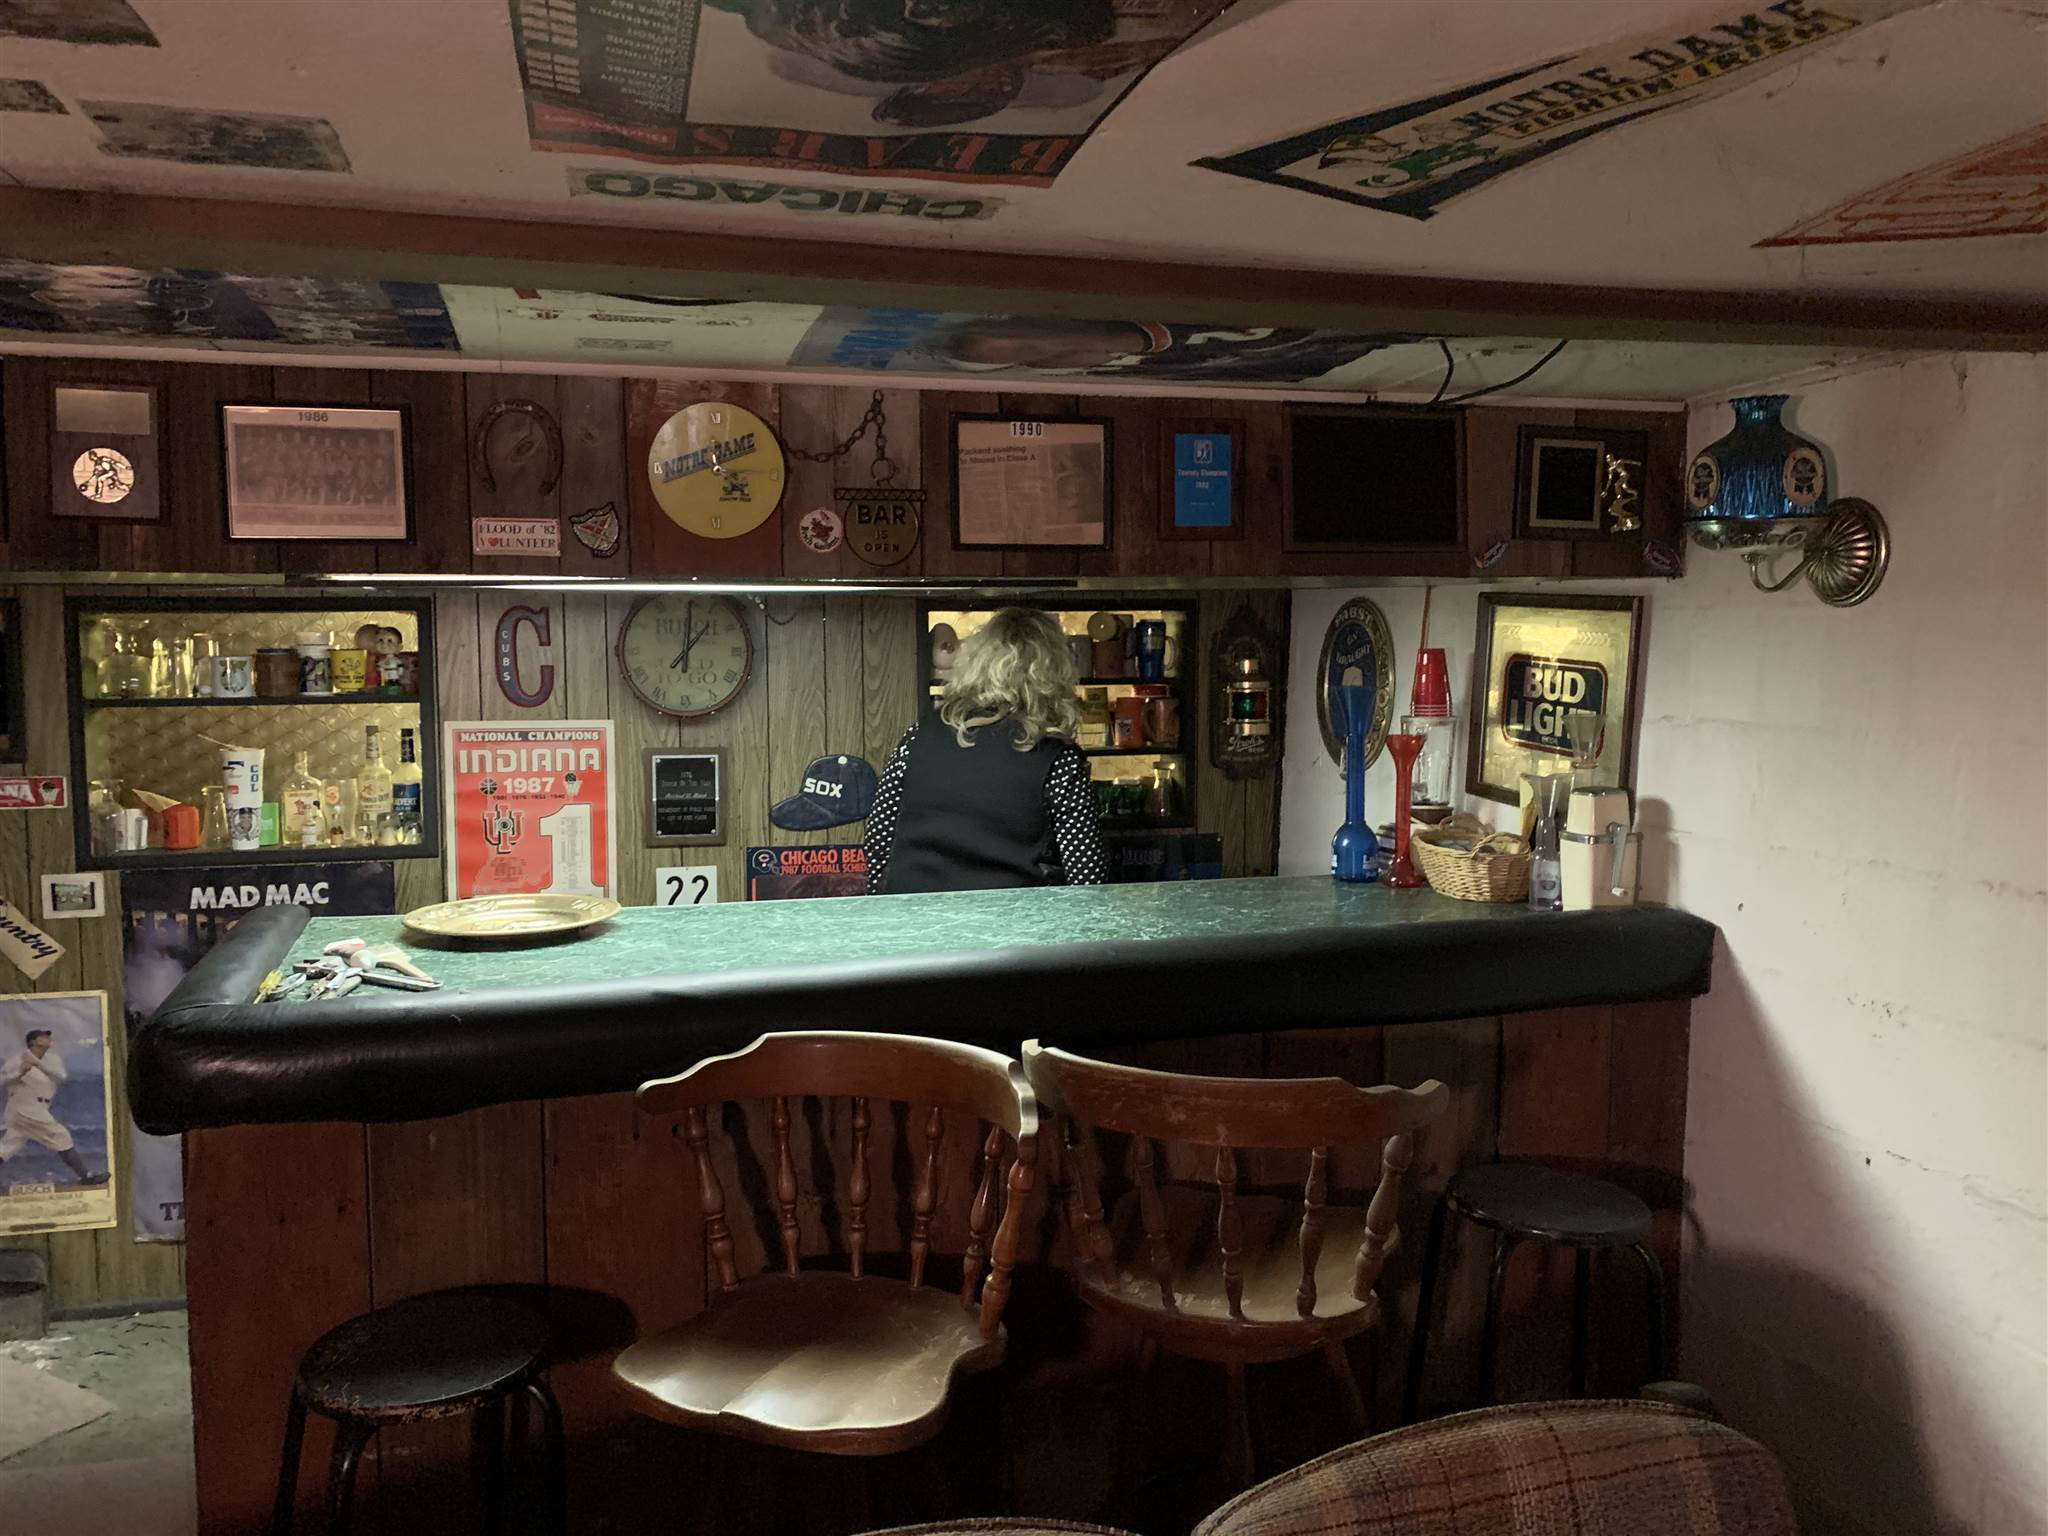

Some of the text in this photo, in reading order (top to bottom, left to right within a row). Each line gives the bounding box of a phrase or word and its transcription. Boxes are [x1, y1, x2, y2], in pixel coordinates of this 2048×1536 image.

[1696, 21, 1830, 77] IRISH
[1452, 0, 1818, 133] NOTRE DAME
[692, 126, 1070, 177] BEARS
[585, 172, 985, 221] CHICAGO
[298, 411, 329, 423] 1986
[1012, 422, 1043, 437] 1990
[663, 432, 756, 478] NOTRE DAME
[855, 503, 906, 525] BAR
[480, 523, 522, 535] FLOOD
[526, 524, 536, 534] of
[863, 541, 900, 553] OPEN
[1334, 607, 1374, 626] PABST
[501, 630, 512, 682] CUBS
[1523, 665, 1586, 704] BUD
[460, 730, 600, 743] NATIONAL CHAMPIONS
[459, 747, 600, 774] INDIANA
[503, 776, 555, 794] 1987
[802, 776, 844, 799] SOX
[780, 847, 867, 866] CHICAGO BEA
[801, 863, 841, 875] FOOTBALL
[843, 862, 868, 874] SCHED
[190, 881, 330, 910] MAD MAC
[0, 916, 58, 960] untry
